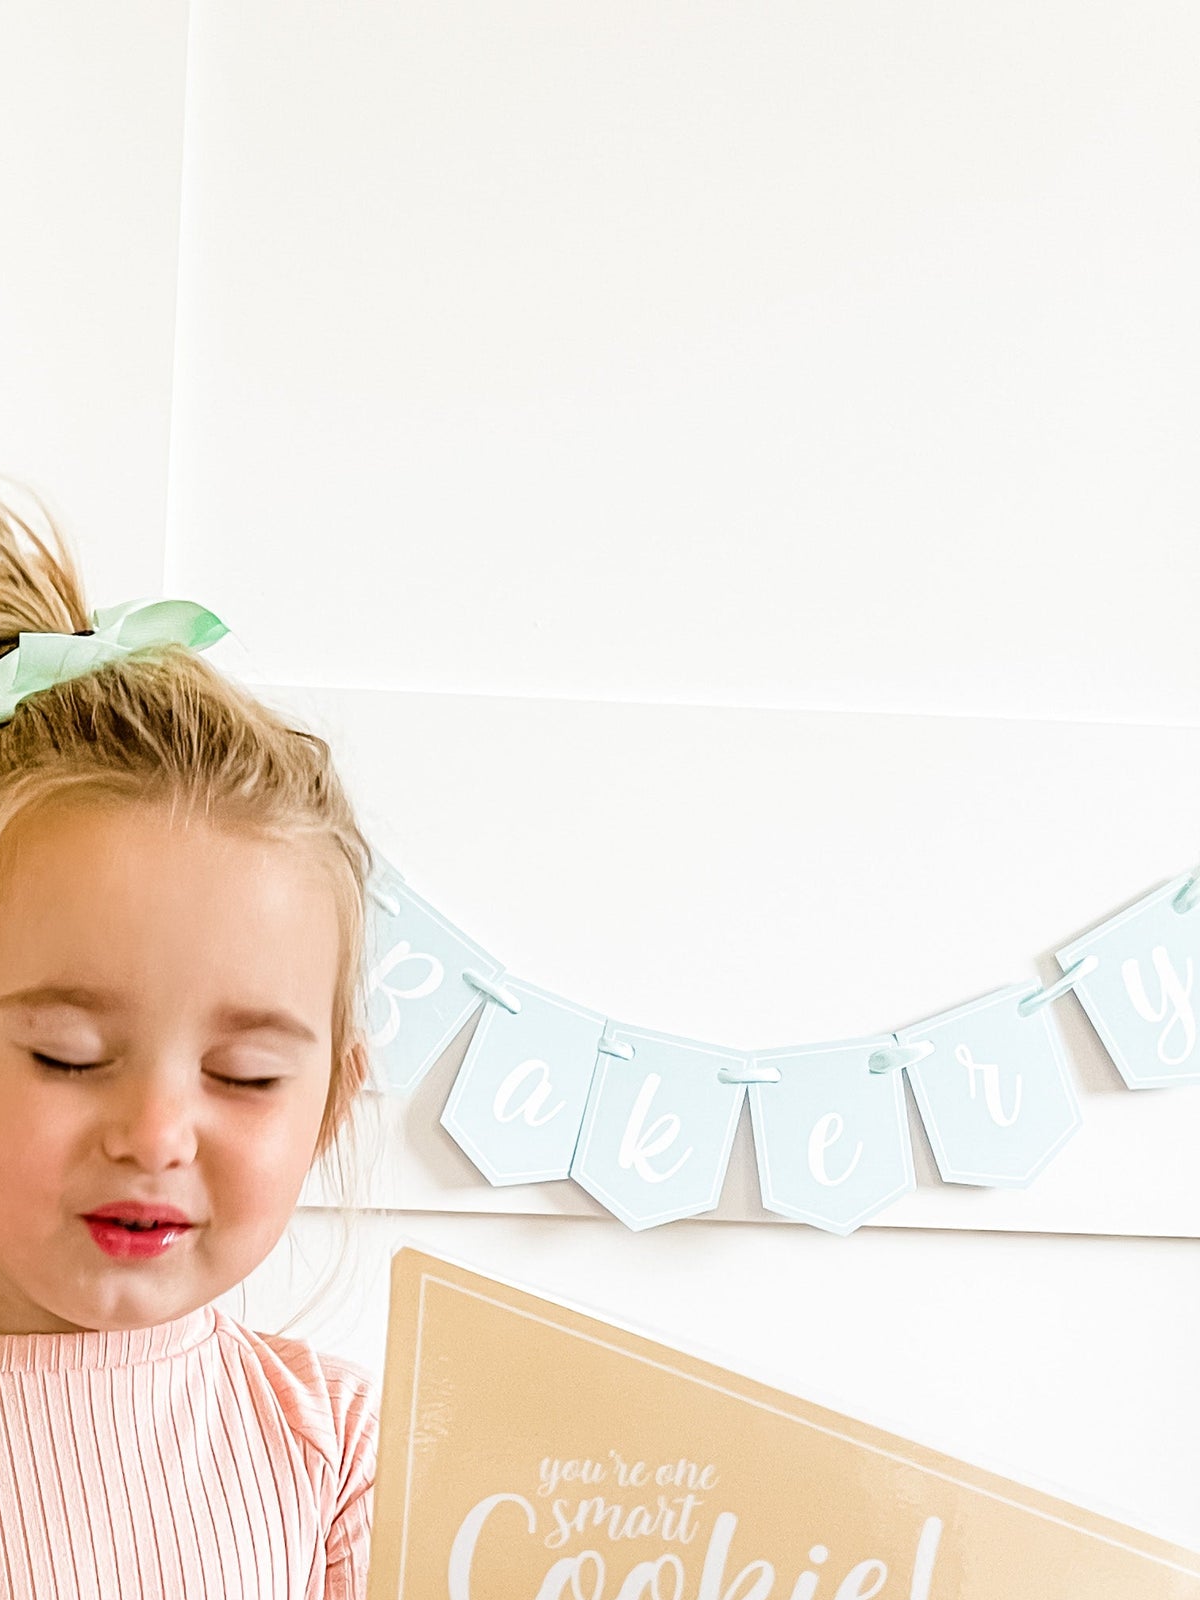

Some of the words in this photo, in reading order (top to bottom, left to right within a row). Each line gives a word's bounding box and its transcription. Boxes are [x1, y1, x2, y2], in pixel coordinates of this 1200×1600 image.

[537, 1450, 650, 1497] you're
[655, 1458, 721, 1490] one
[544, 1493, 705, 1549] smart
